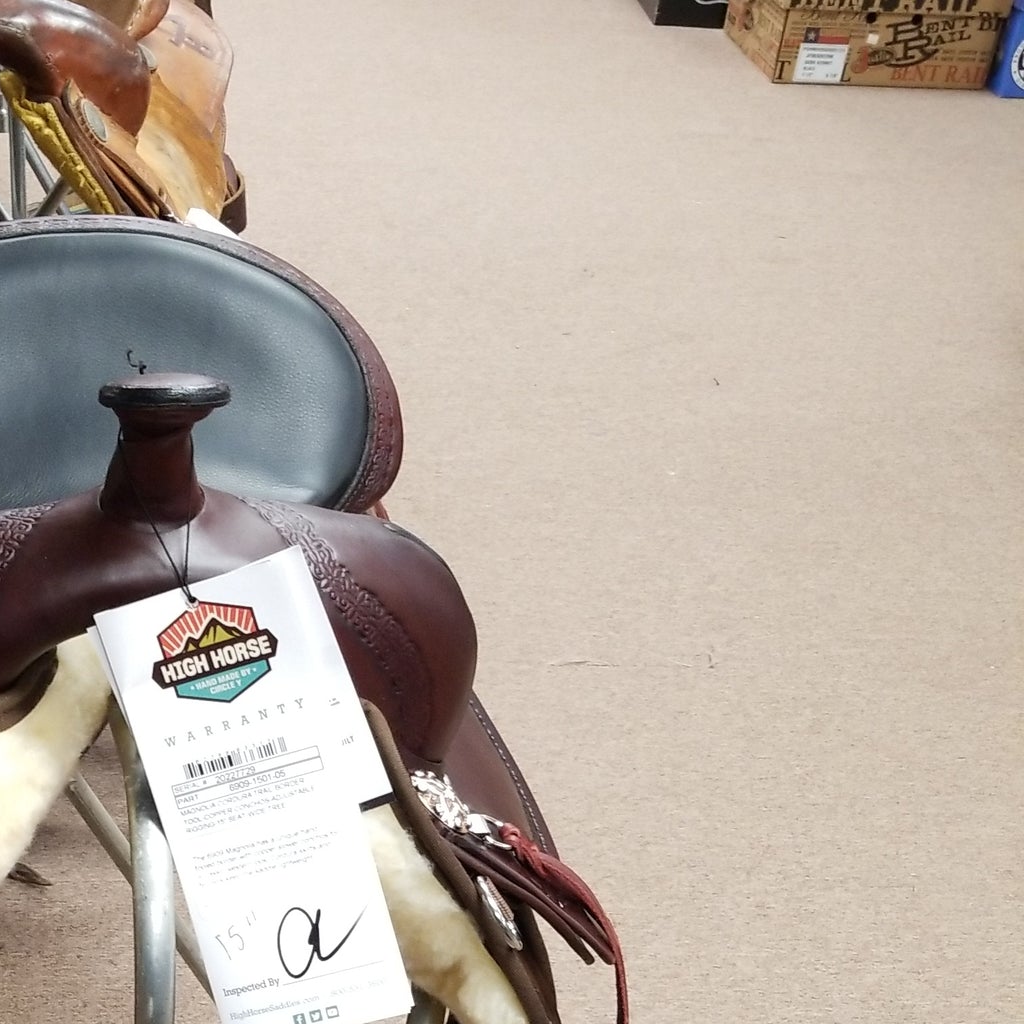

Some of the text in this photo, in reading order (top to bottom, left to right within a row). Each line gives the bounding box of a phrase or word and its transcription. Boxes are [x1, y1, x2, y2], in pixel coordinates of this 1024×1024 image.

[160, 635, 273, 684] HIGH HORSE
[195, 667, 252, 691] HAND MADE BY
[164, 698, 304, 748] WARRANTY
[177, 794, 199, 804] PART
[222, 976, 280, 998] Inspected By
